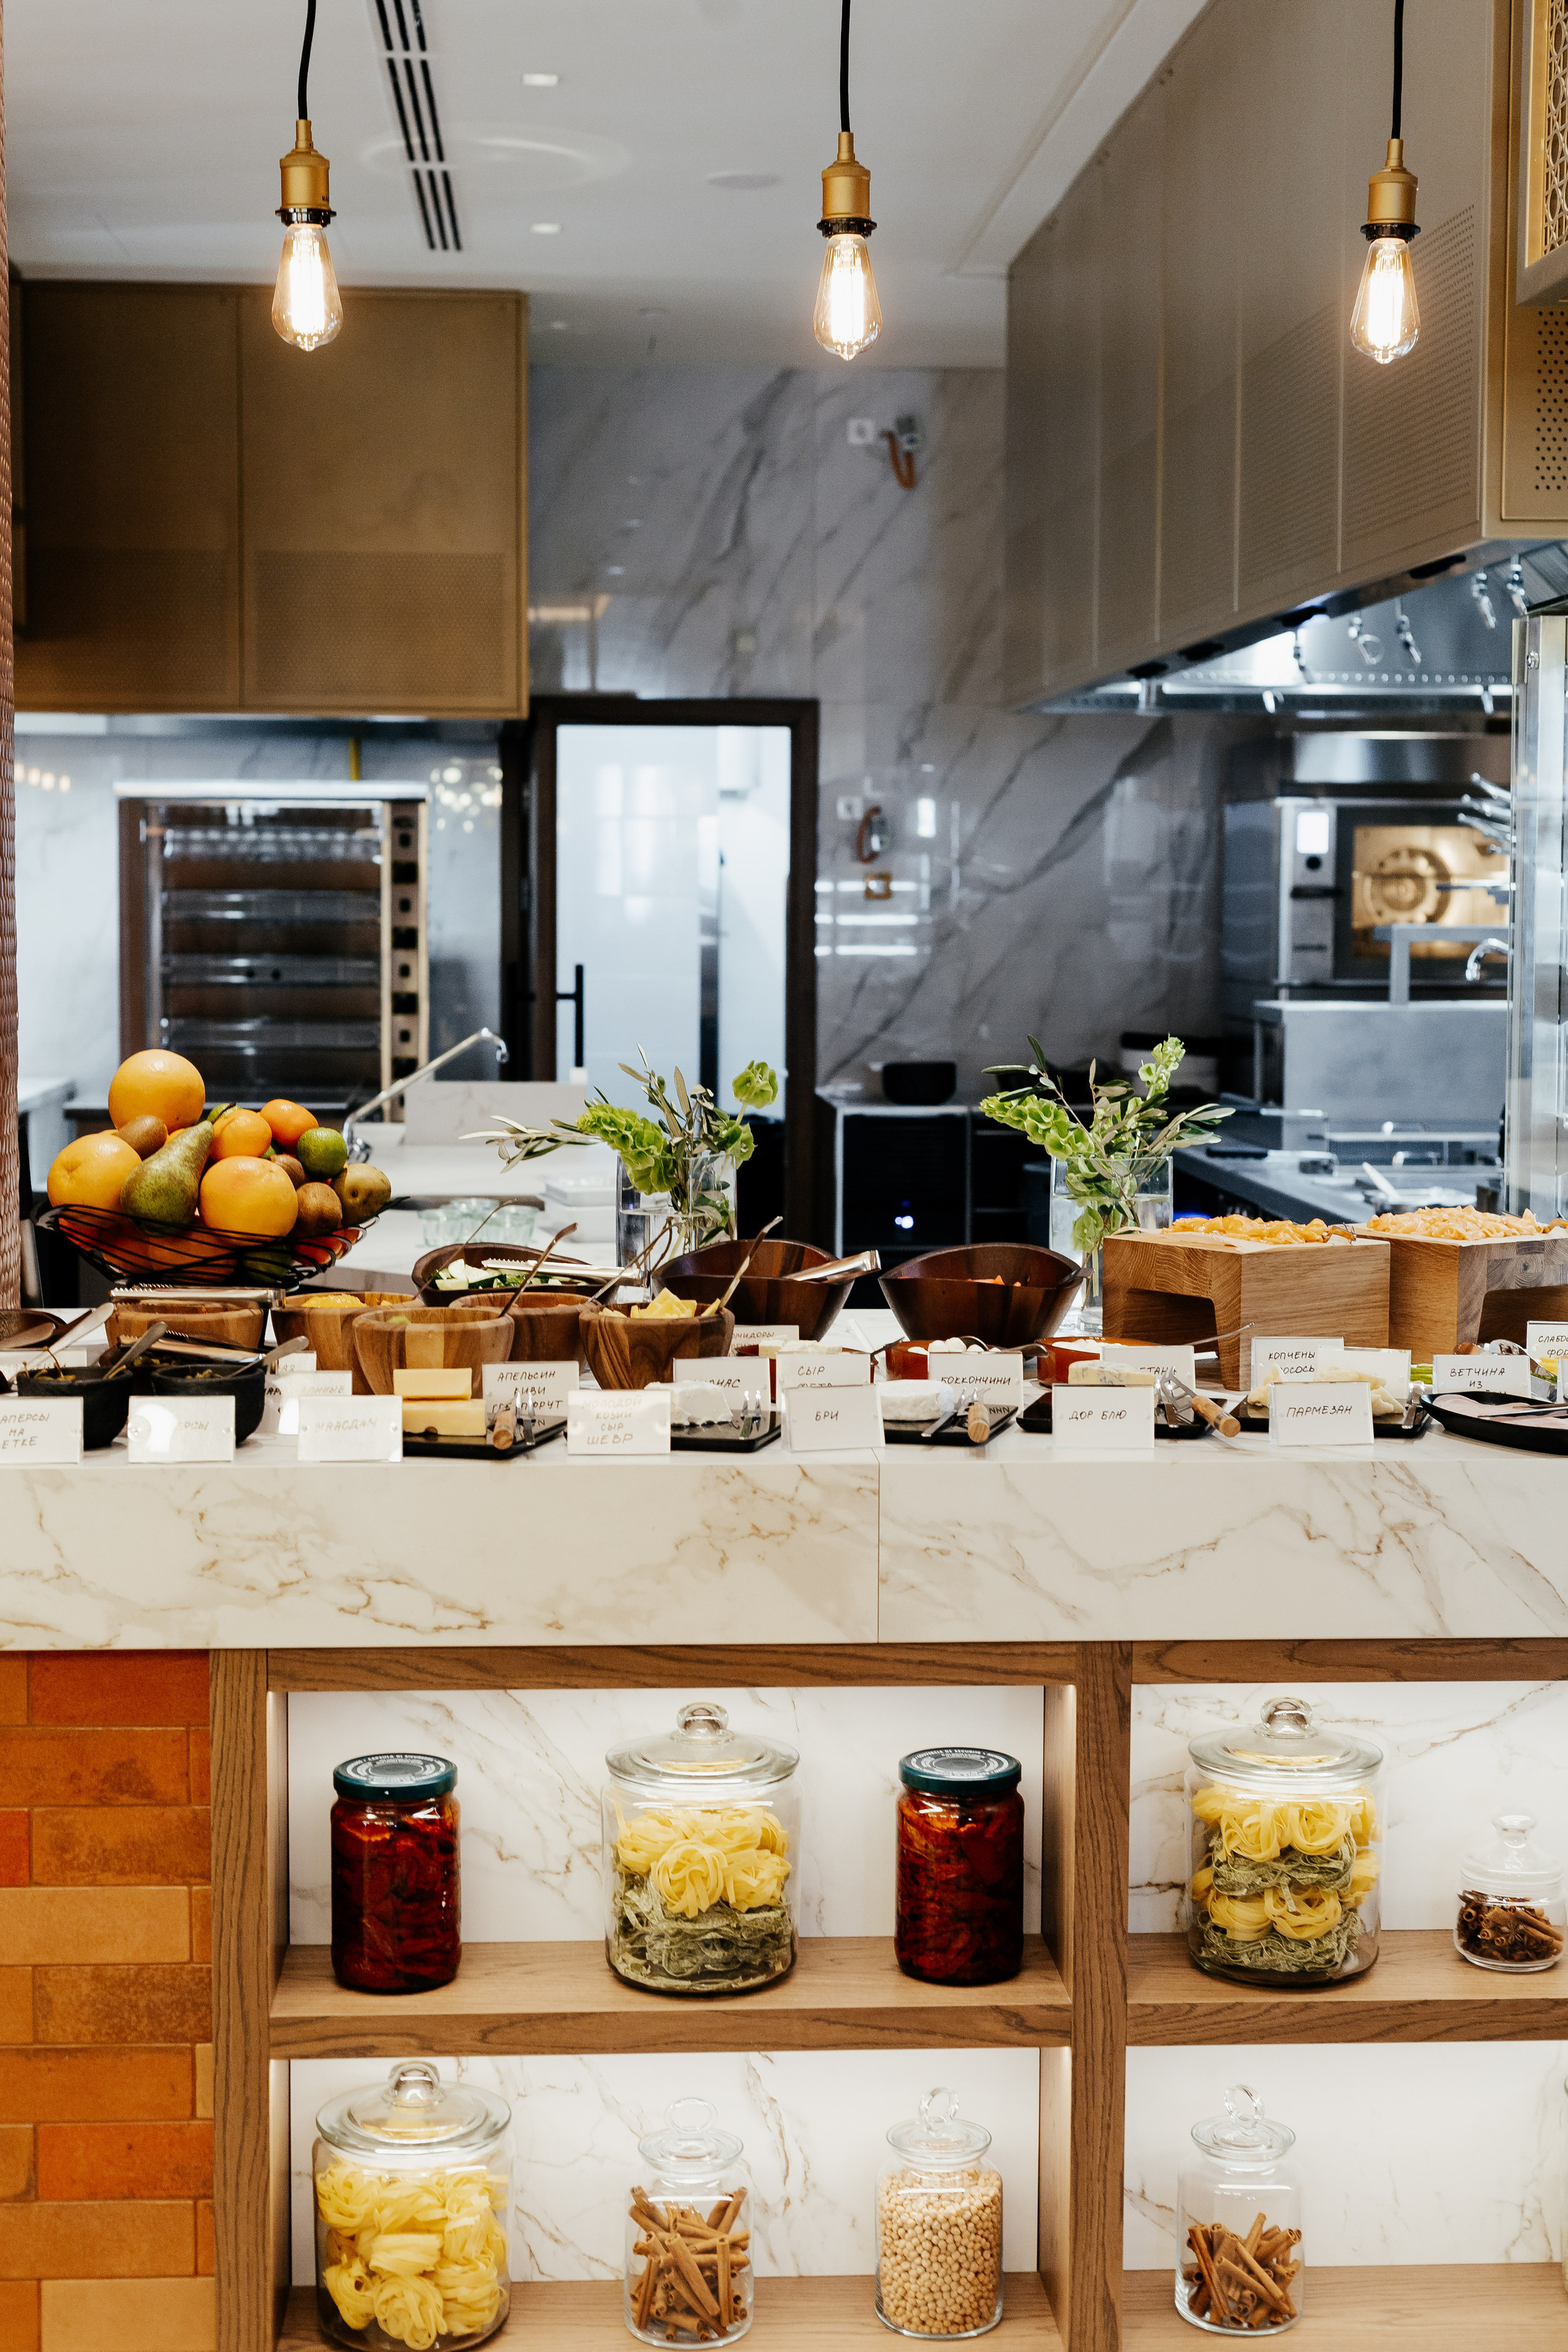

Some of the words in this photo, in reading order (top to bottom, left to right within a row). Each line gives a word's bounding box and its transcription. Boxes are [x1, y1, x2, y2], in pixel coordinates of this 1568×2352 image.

[797, 1365, 825, 1376] СЫР
[1281, 1365, 1315, 1374] ОСОСЬ
[1450, 1367, 1506, 1377] ВЕТЧИНА
[497, 1370, 556, 1382] АПЕЛЬСИН
[941, 1376, 1011, 1385] БОККОНЧИНИ
[1469, 1380, 1483, 1389] ИЗ
[582, 1395, 643, 1409] МОЛОДОЙ
[815, 1411, 839, 1422] БРИ
[1069, 1410, 1093, 1421] ДОР
[1101, 1410, 1127, 1420] БЛЮ
[1286, 1405, 1352, 1418] ПАРМЕЗАН
[0, 1413, 50, 1424] АПЕРСЫ
[9, 1428, 24, 1436] НА
[600, 1423, 624, 1432] СЫР
[1, 1436, 38, 1449] ЕТКЕ
[587, 1433, 633, 1446] ШЕВР
